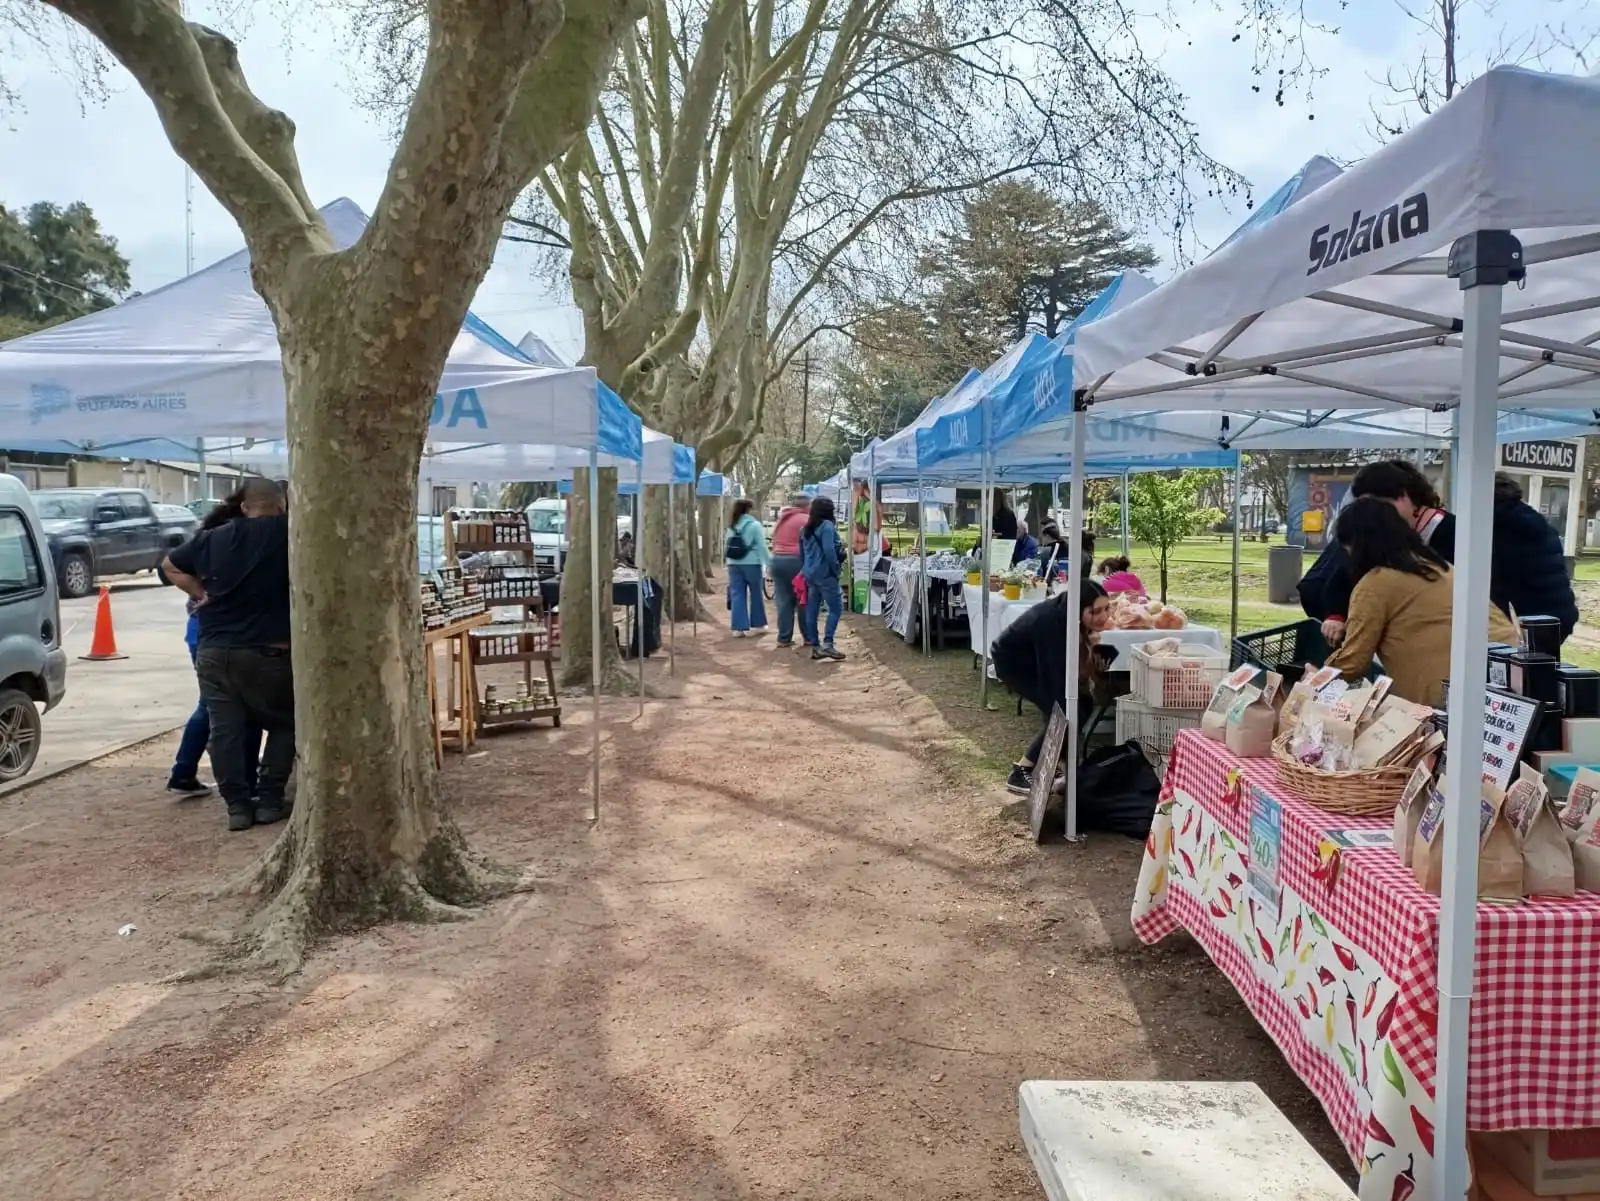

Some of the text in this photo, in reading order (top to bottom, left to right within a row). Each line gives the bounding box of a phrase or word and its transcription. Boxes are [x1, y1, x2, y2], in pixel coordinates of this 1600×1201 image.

[1305, 192, 1429, 277] Solana
[76, 398, 187, 412] BUENOS AIRES
